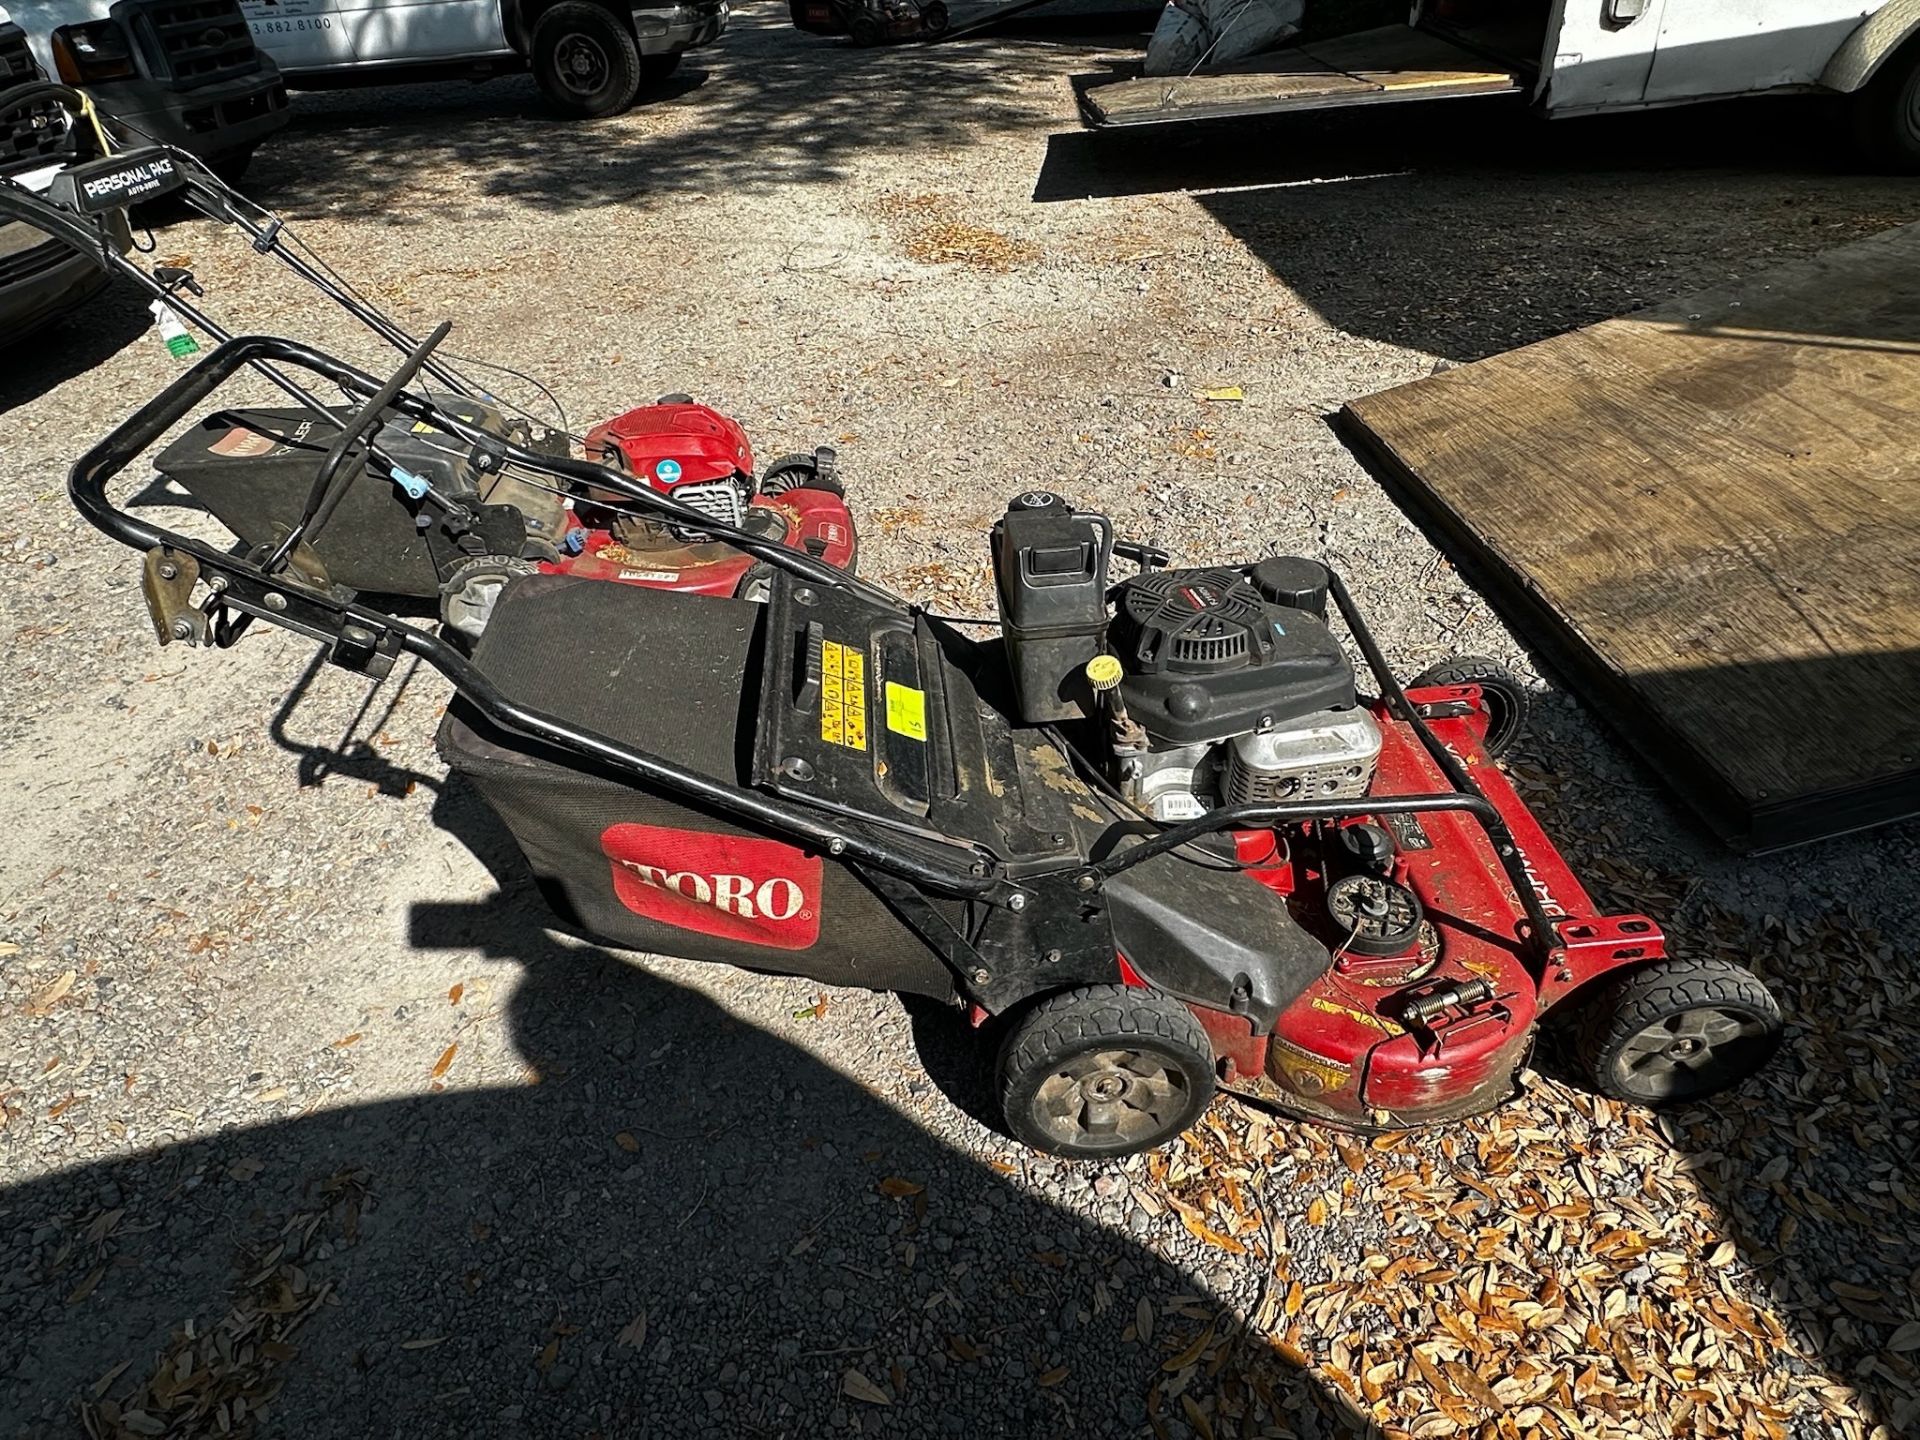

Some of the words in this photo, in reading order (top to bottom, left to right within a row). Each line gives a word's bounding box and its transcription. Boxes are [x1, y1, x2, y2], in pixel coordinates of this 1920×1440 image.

[83, 166, 152, 199] PERSONAL
[148, 158, 174, 177] PACE
[621, 859, 805, 921] TORO
